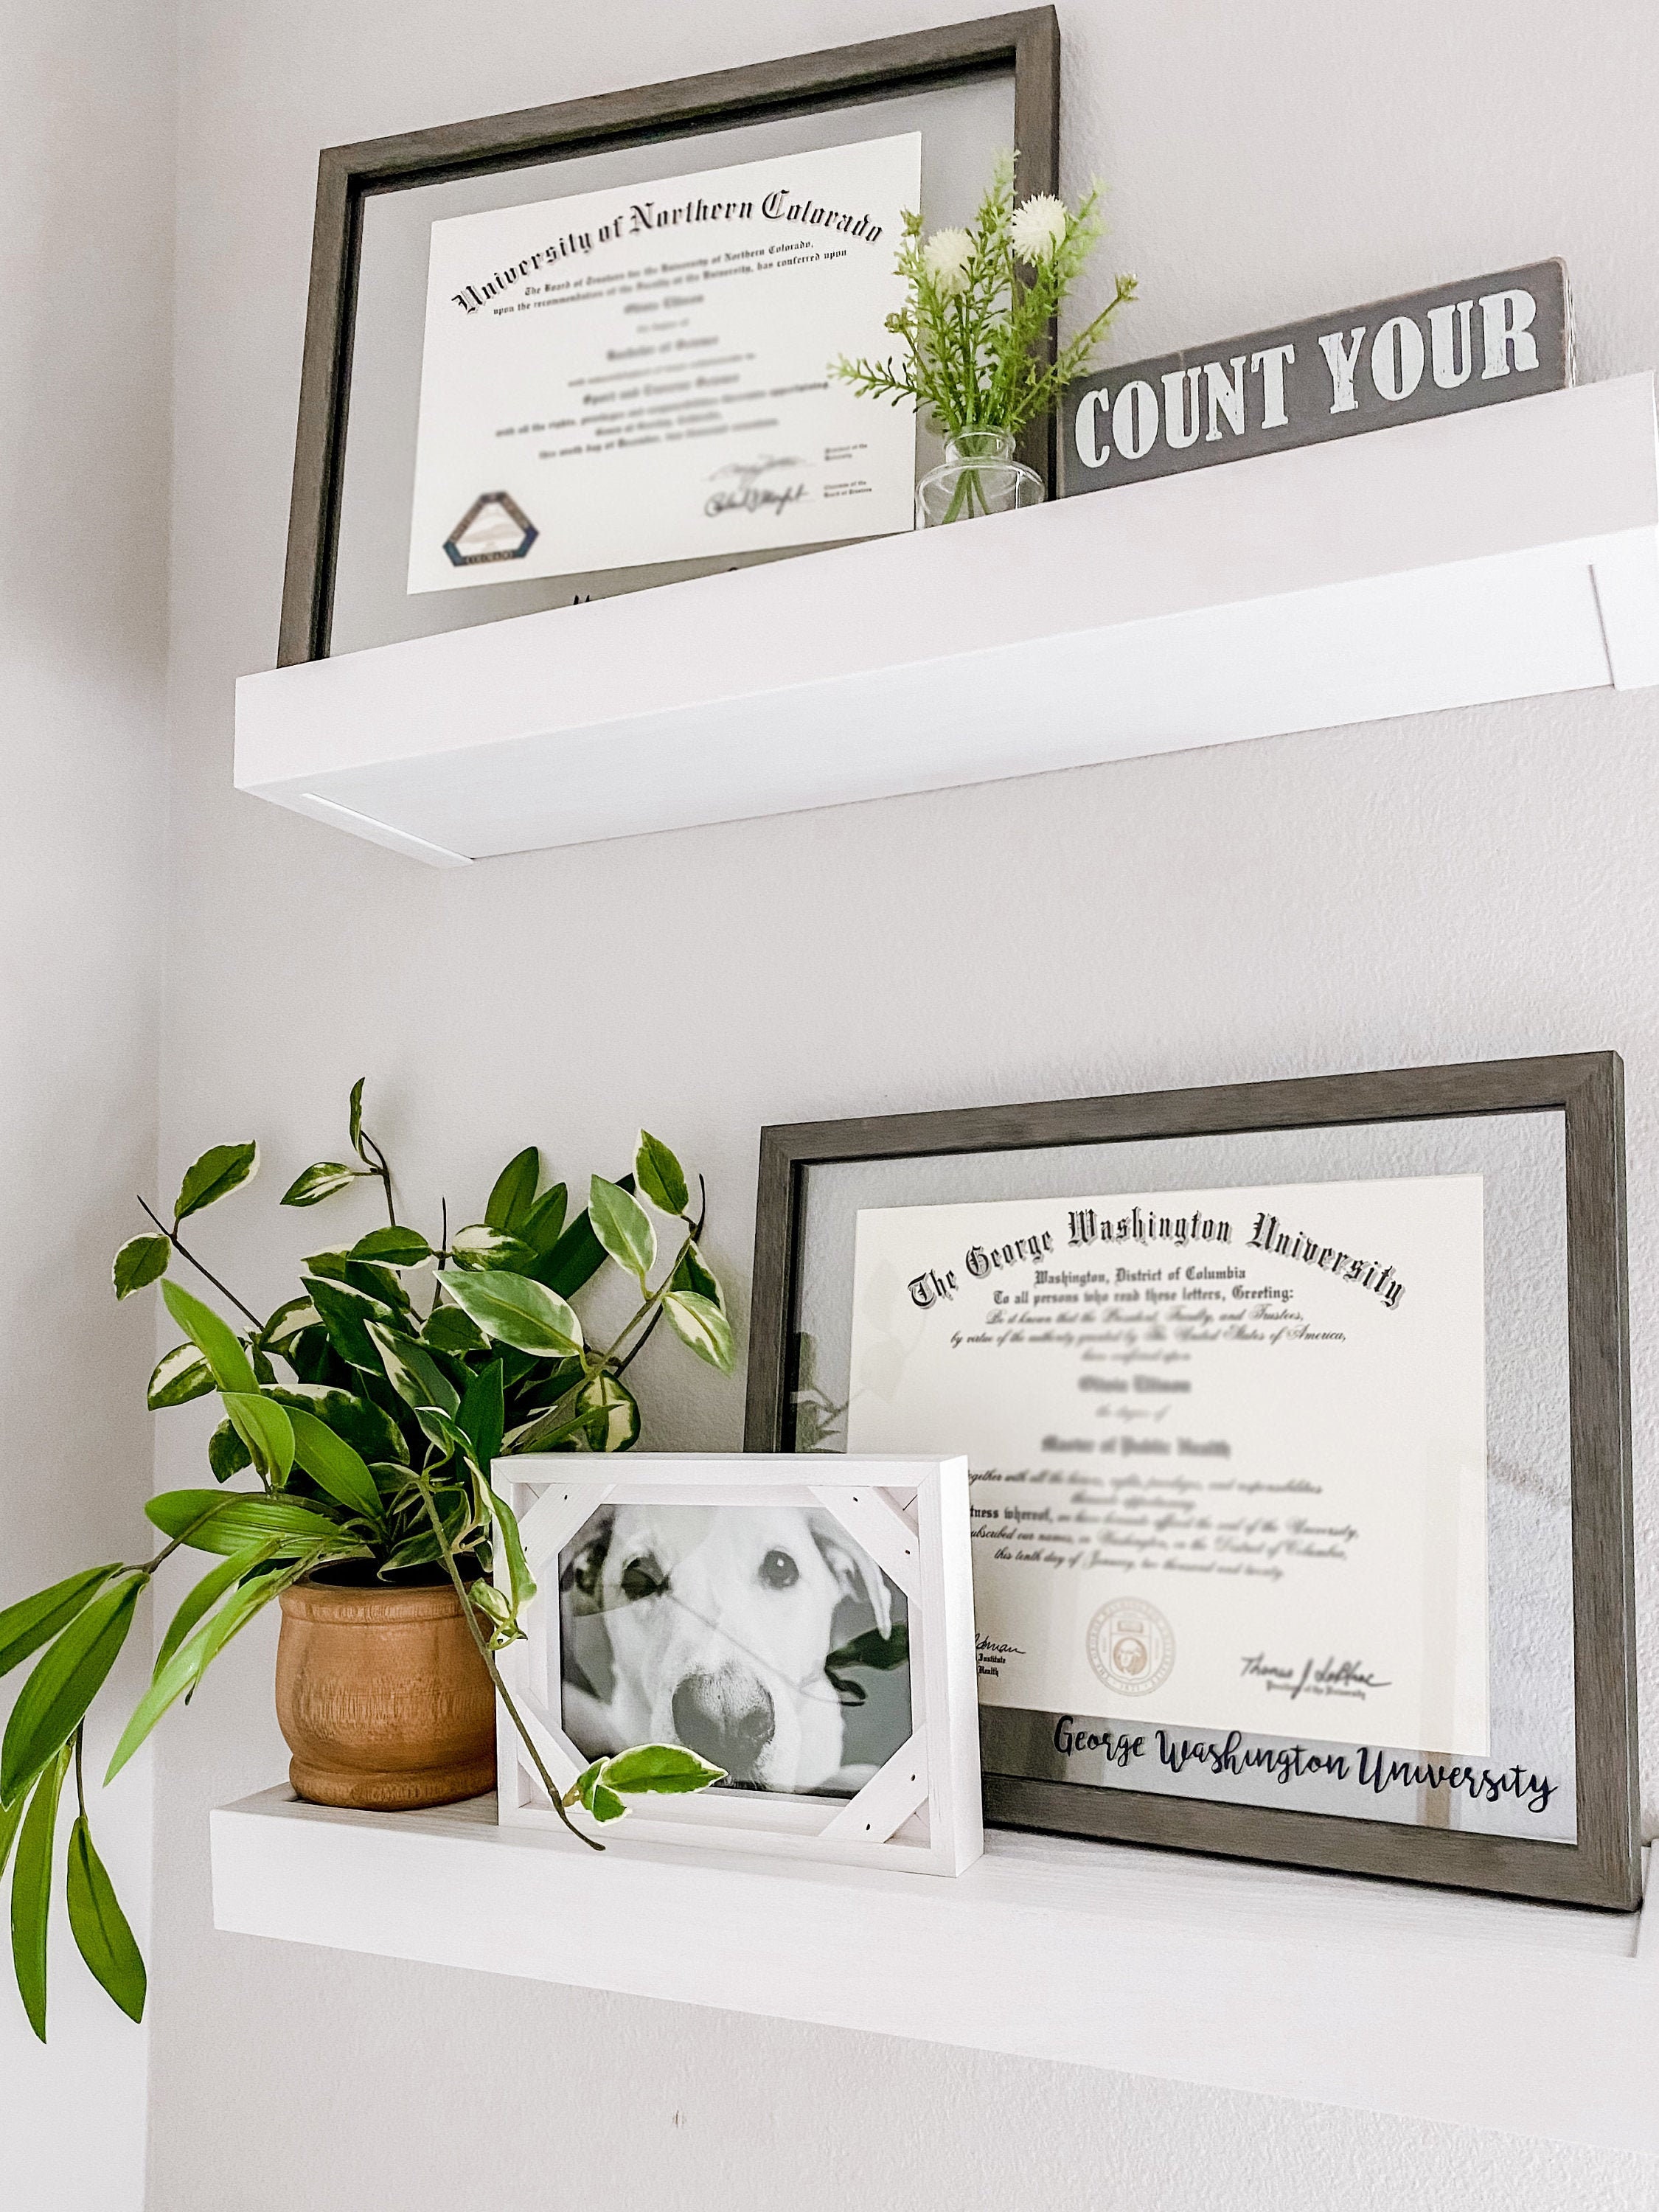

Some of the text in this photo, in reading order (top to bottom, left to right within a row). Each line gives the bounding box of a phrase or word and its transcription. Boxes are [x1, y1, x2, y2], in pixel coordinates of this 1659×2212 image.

[451, 232, 591, 315] University
[598, 215, 624, 243] of
[628, 198, 754, 234] Northern
[762, 189, 884, 244] Colorado
[525, 287, 540, 296] The
[724, 248, 765, 262] Northern
[768, 240, 814, 254] Colorado,
[493, 306, 515, 315] upon
[518, 301, 531, 310] the
[776, 252, 821, 268] conferred
[824, 248, 847, 262] upon
[1074, 288, 1540, 468] COUNT YOUR
[907, 1206, 1406, 1310] The George Washington University
[1033, 1265, 1246, 1288] Washington, District of Columbia
[993, 1290, 1009, 1305] To
[1014, 1290, 1029, 1304] all
[1033, 1292, 1079, 1307] persons
[1181, 1286, 1226, 1303] letters,
[1231, 1284, 1294, 1303] Greeting:
[1247, 1302, 1304, 1324] Trustees,
[950, 1329, 963, 1349] by
[966, 1332, 994, 1344] virtue
[1285, 1323, 1347, 1343] America,
[993, 1545, 1014, 1561] this
[977, 1652, 1006, 1664] Institute
[978, 1665, 999, 1677] Health
[1053, 1713, 1559, 1813] George Washington University
